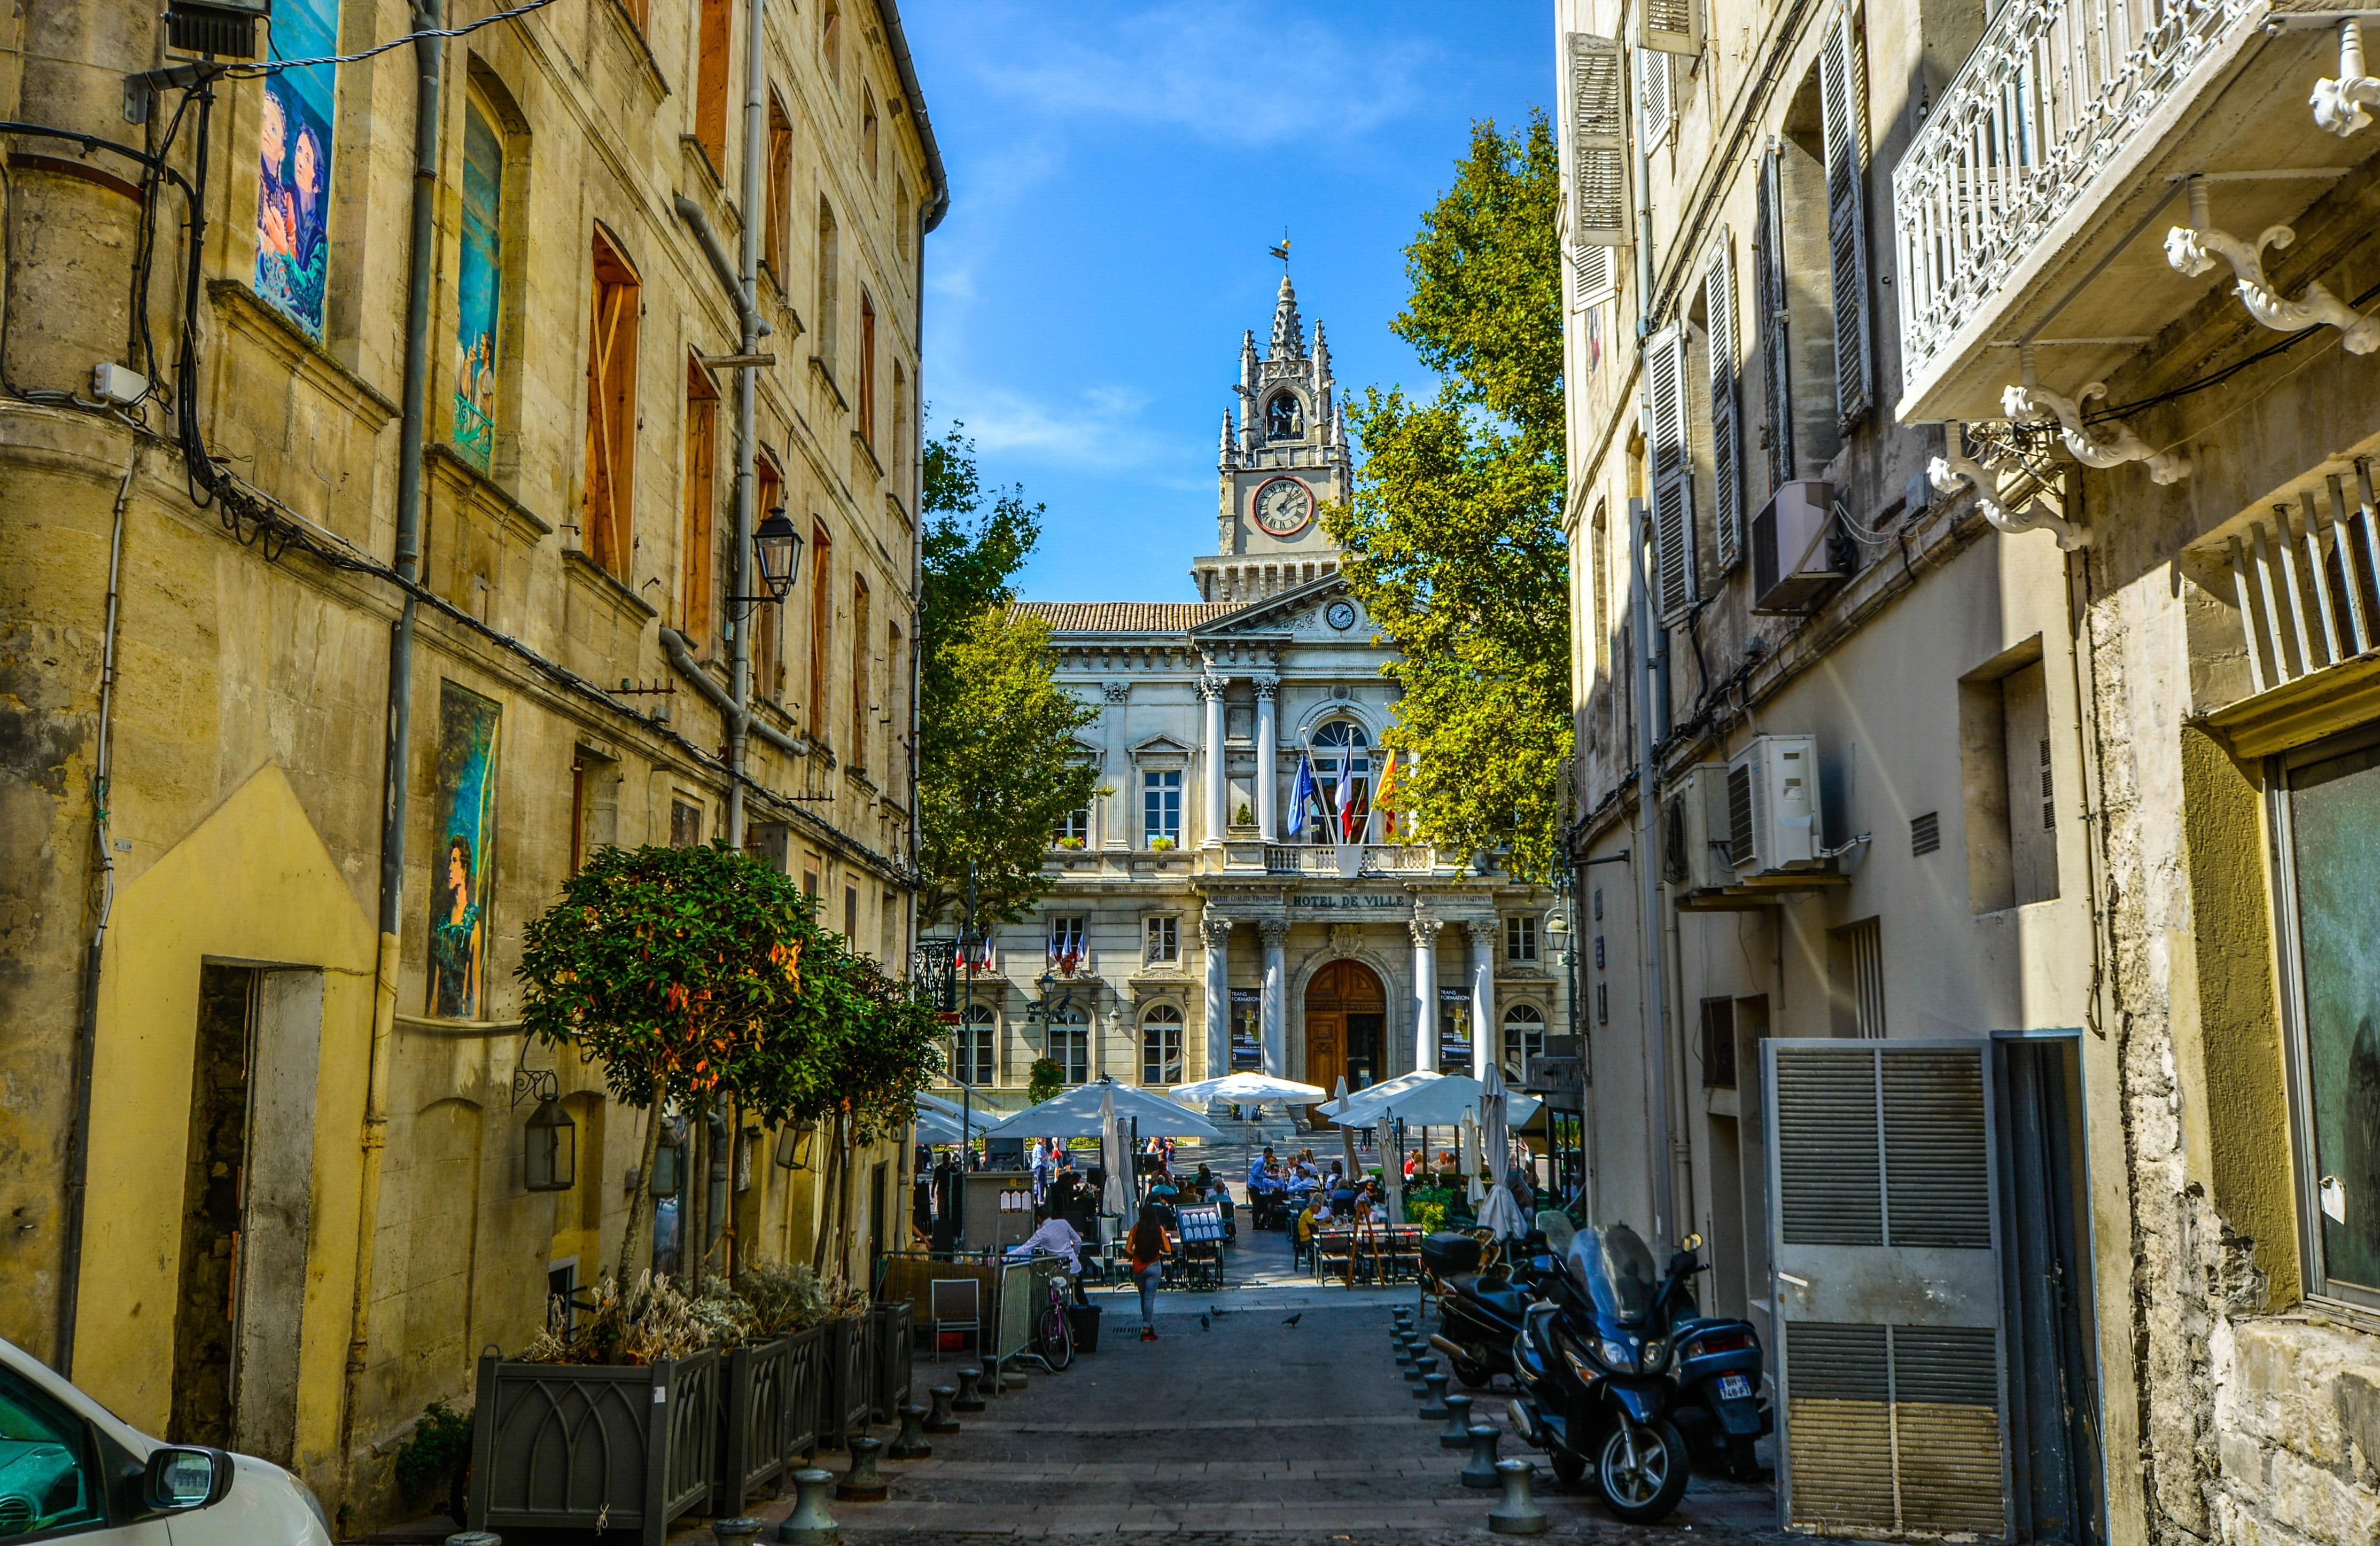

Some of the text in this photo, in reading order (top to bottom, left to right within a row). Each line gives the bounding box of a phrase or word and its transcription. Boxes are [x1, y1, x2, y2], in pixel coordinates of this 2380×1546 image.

[1294, 896, 1404, 906] HOTEL DE VILLE
